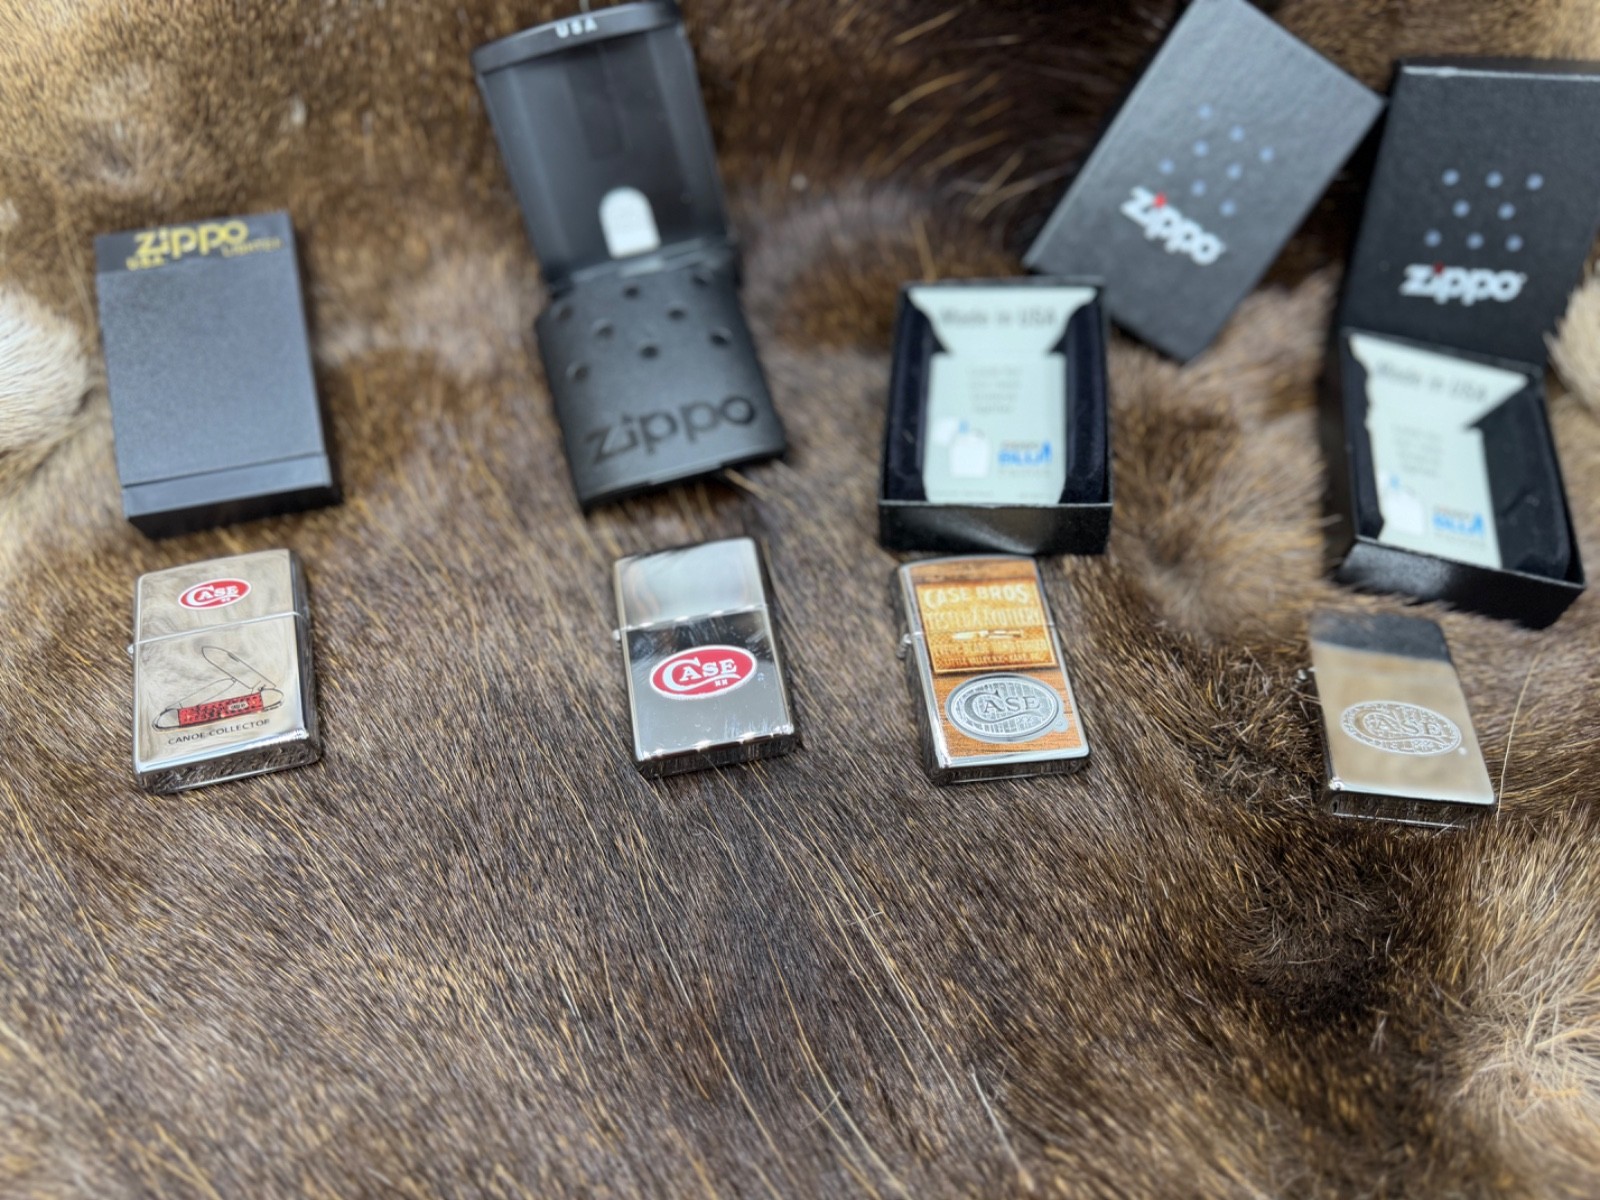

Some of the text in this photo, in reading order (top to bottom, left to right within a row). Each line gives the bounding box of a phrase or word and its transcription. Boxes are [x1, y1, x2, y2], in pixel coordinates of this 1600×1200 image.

[555, 17, 598, 38] USA
[133, 219, 249, 260] zippo
[1120, 187, 1226, 265] zippo
[1400, 262, 1526, 305] zippo
[584, 396, 756, 466] zippo
[923, 587, 971, 609] CASE
[662, 656, 741, 691] CASE
[168, 718, 270, 745] CANOE COLLECTOR
